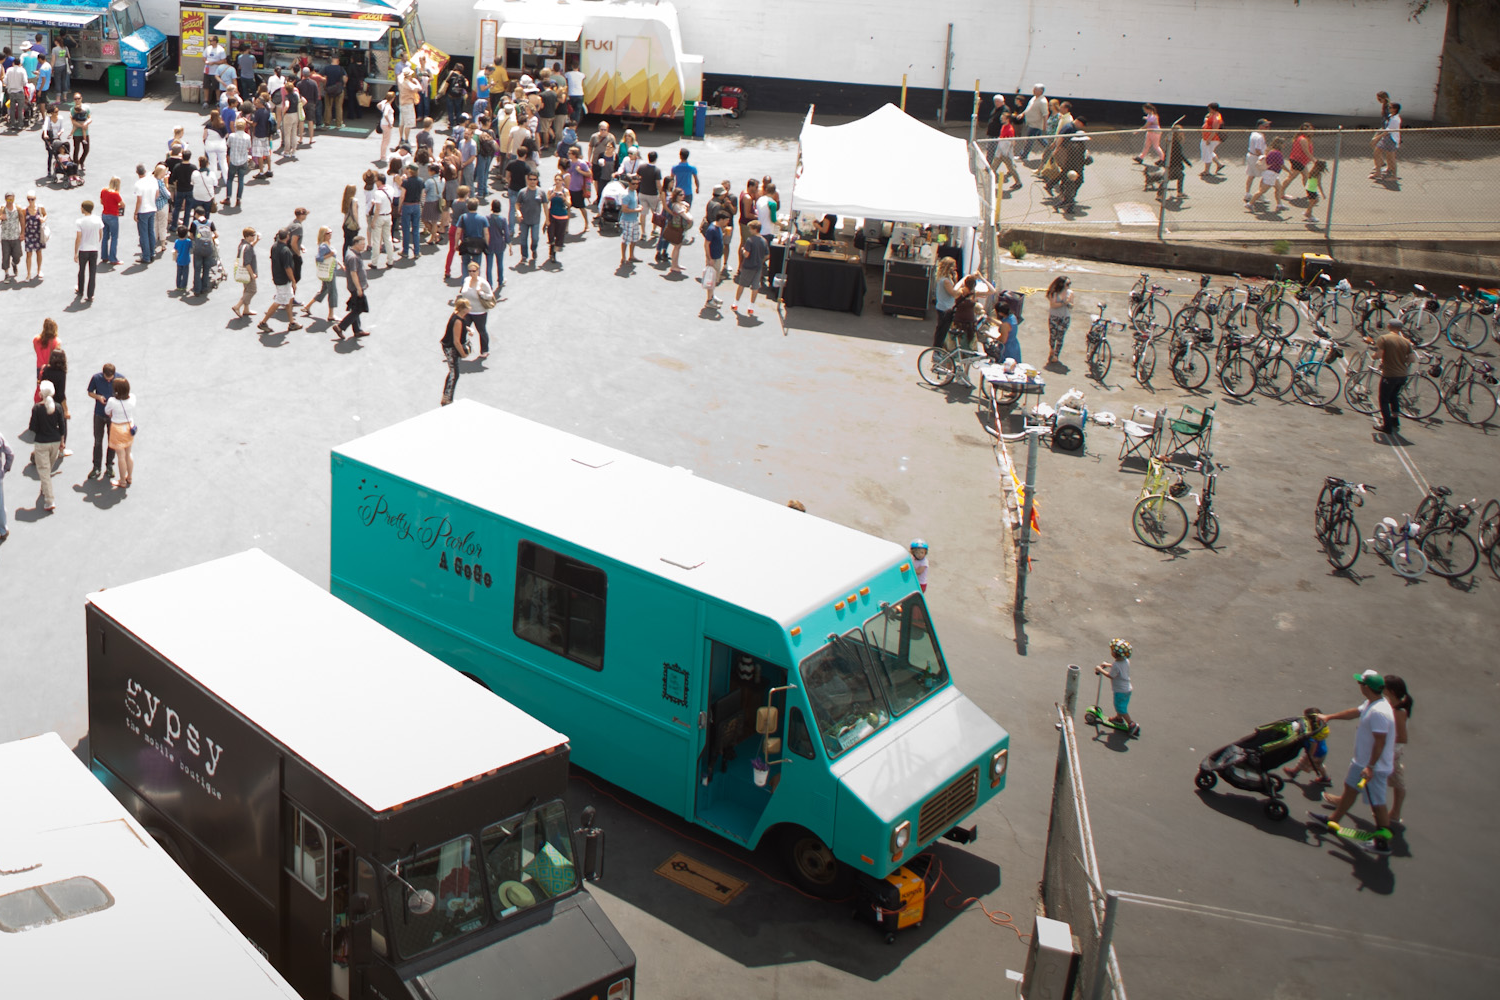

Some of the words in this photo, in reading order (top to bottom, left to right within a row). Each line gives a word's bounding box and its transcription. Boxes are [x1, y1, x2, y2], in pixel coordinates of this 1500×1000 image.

[584, 39, 613, 51] FUKI
[358, 494, 414, 541] Pretty
[417, 516, 482, 558] Parlor
[439, 551, 449, 571] A
[124, 678, 223, 776] gypsy
[125, 717, 140, 735] the
[144, 733, 174, 762] mobile
[180, 760, 222, 800] boutique
